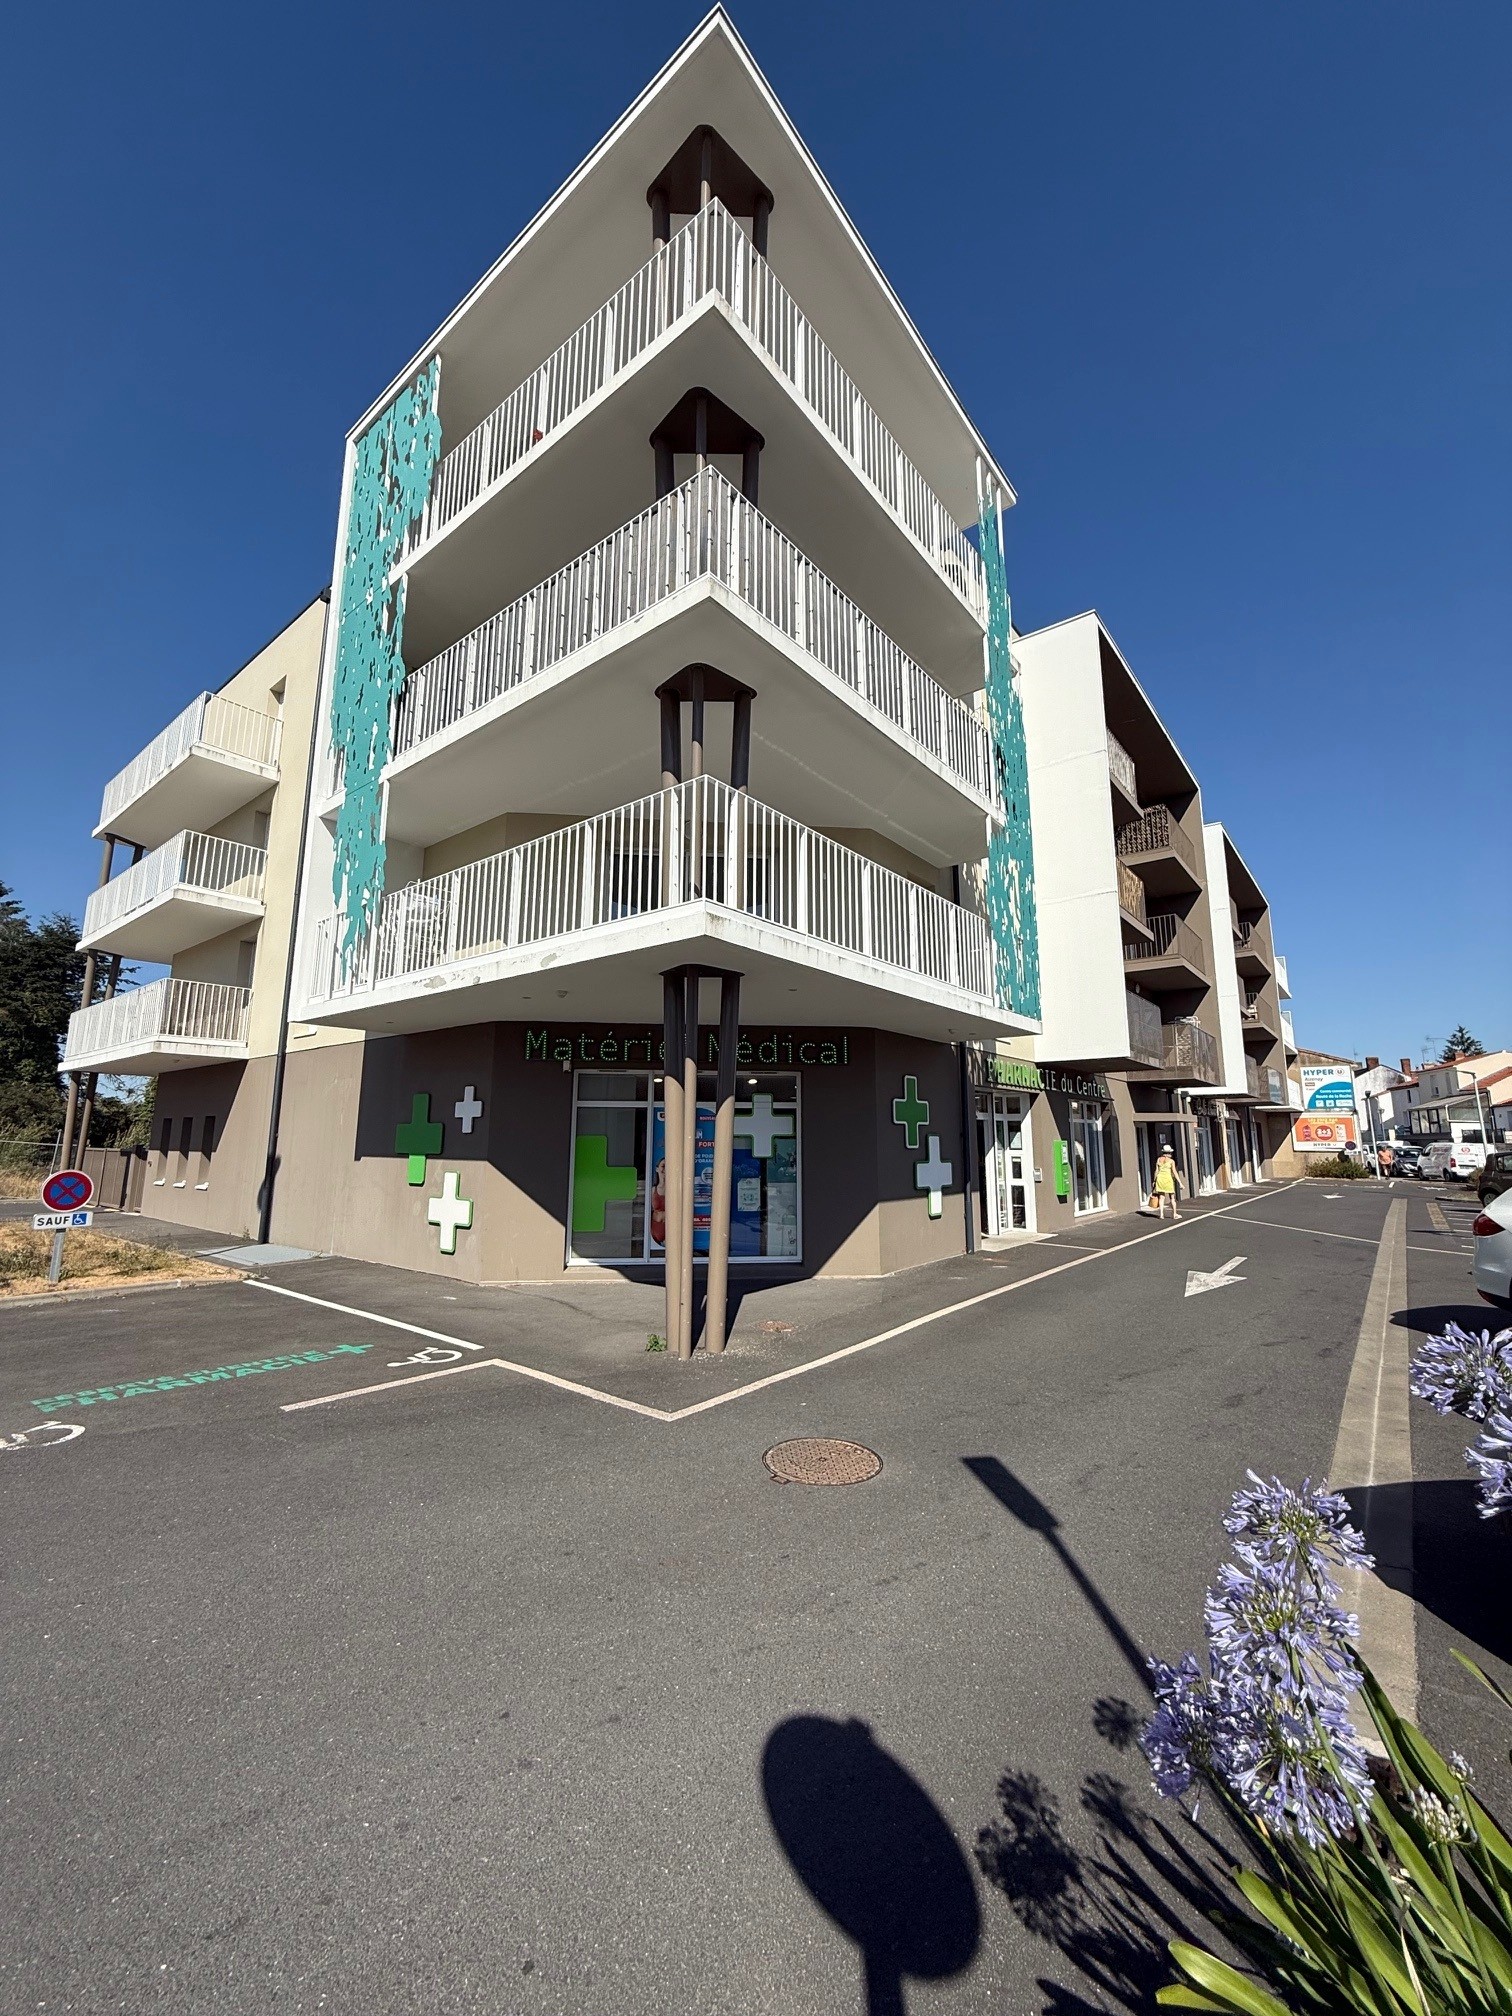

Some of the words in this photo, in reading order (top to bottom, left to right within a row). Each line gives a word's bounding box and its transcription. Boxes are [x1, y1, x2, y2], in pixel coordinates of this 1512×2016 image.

[525, 1029, 688, 1062] Matéri
[987, 1055, 1057, 1091] PHARMACIE
[1061, 1074, 1073, 1093] du
[1076, 1075, 1106, 1098] Centre
[37, 1216, 70, 1226] SAUF
[35, 1352, 335, 1413] PHARMACIE
